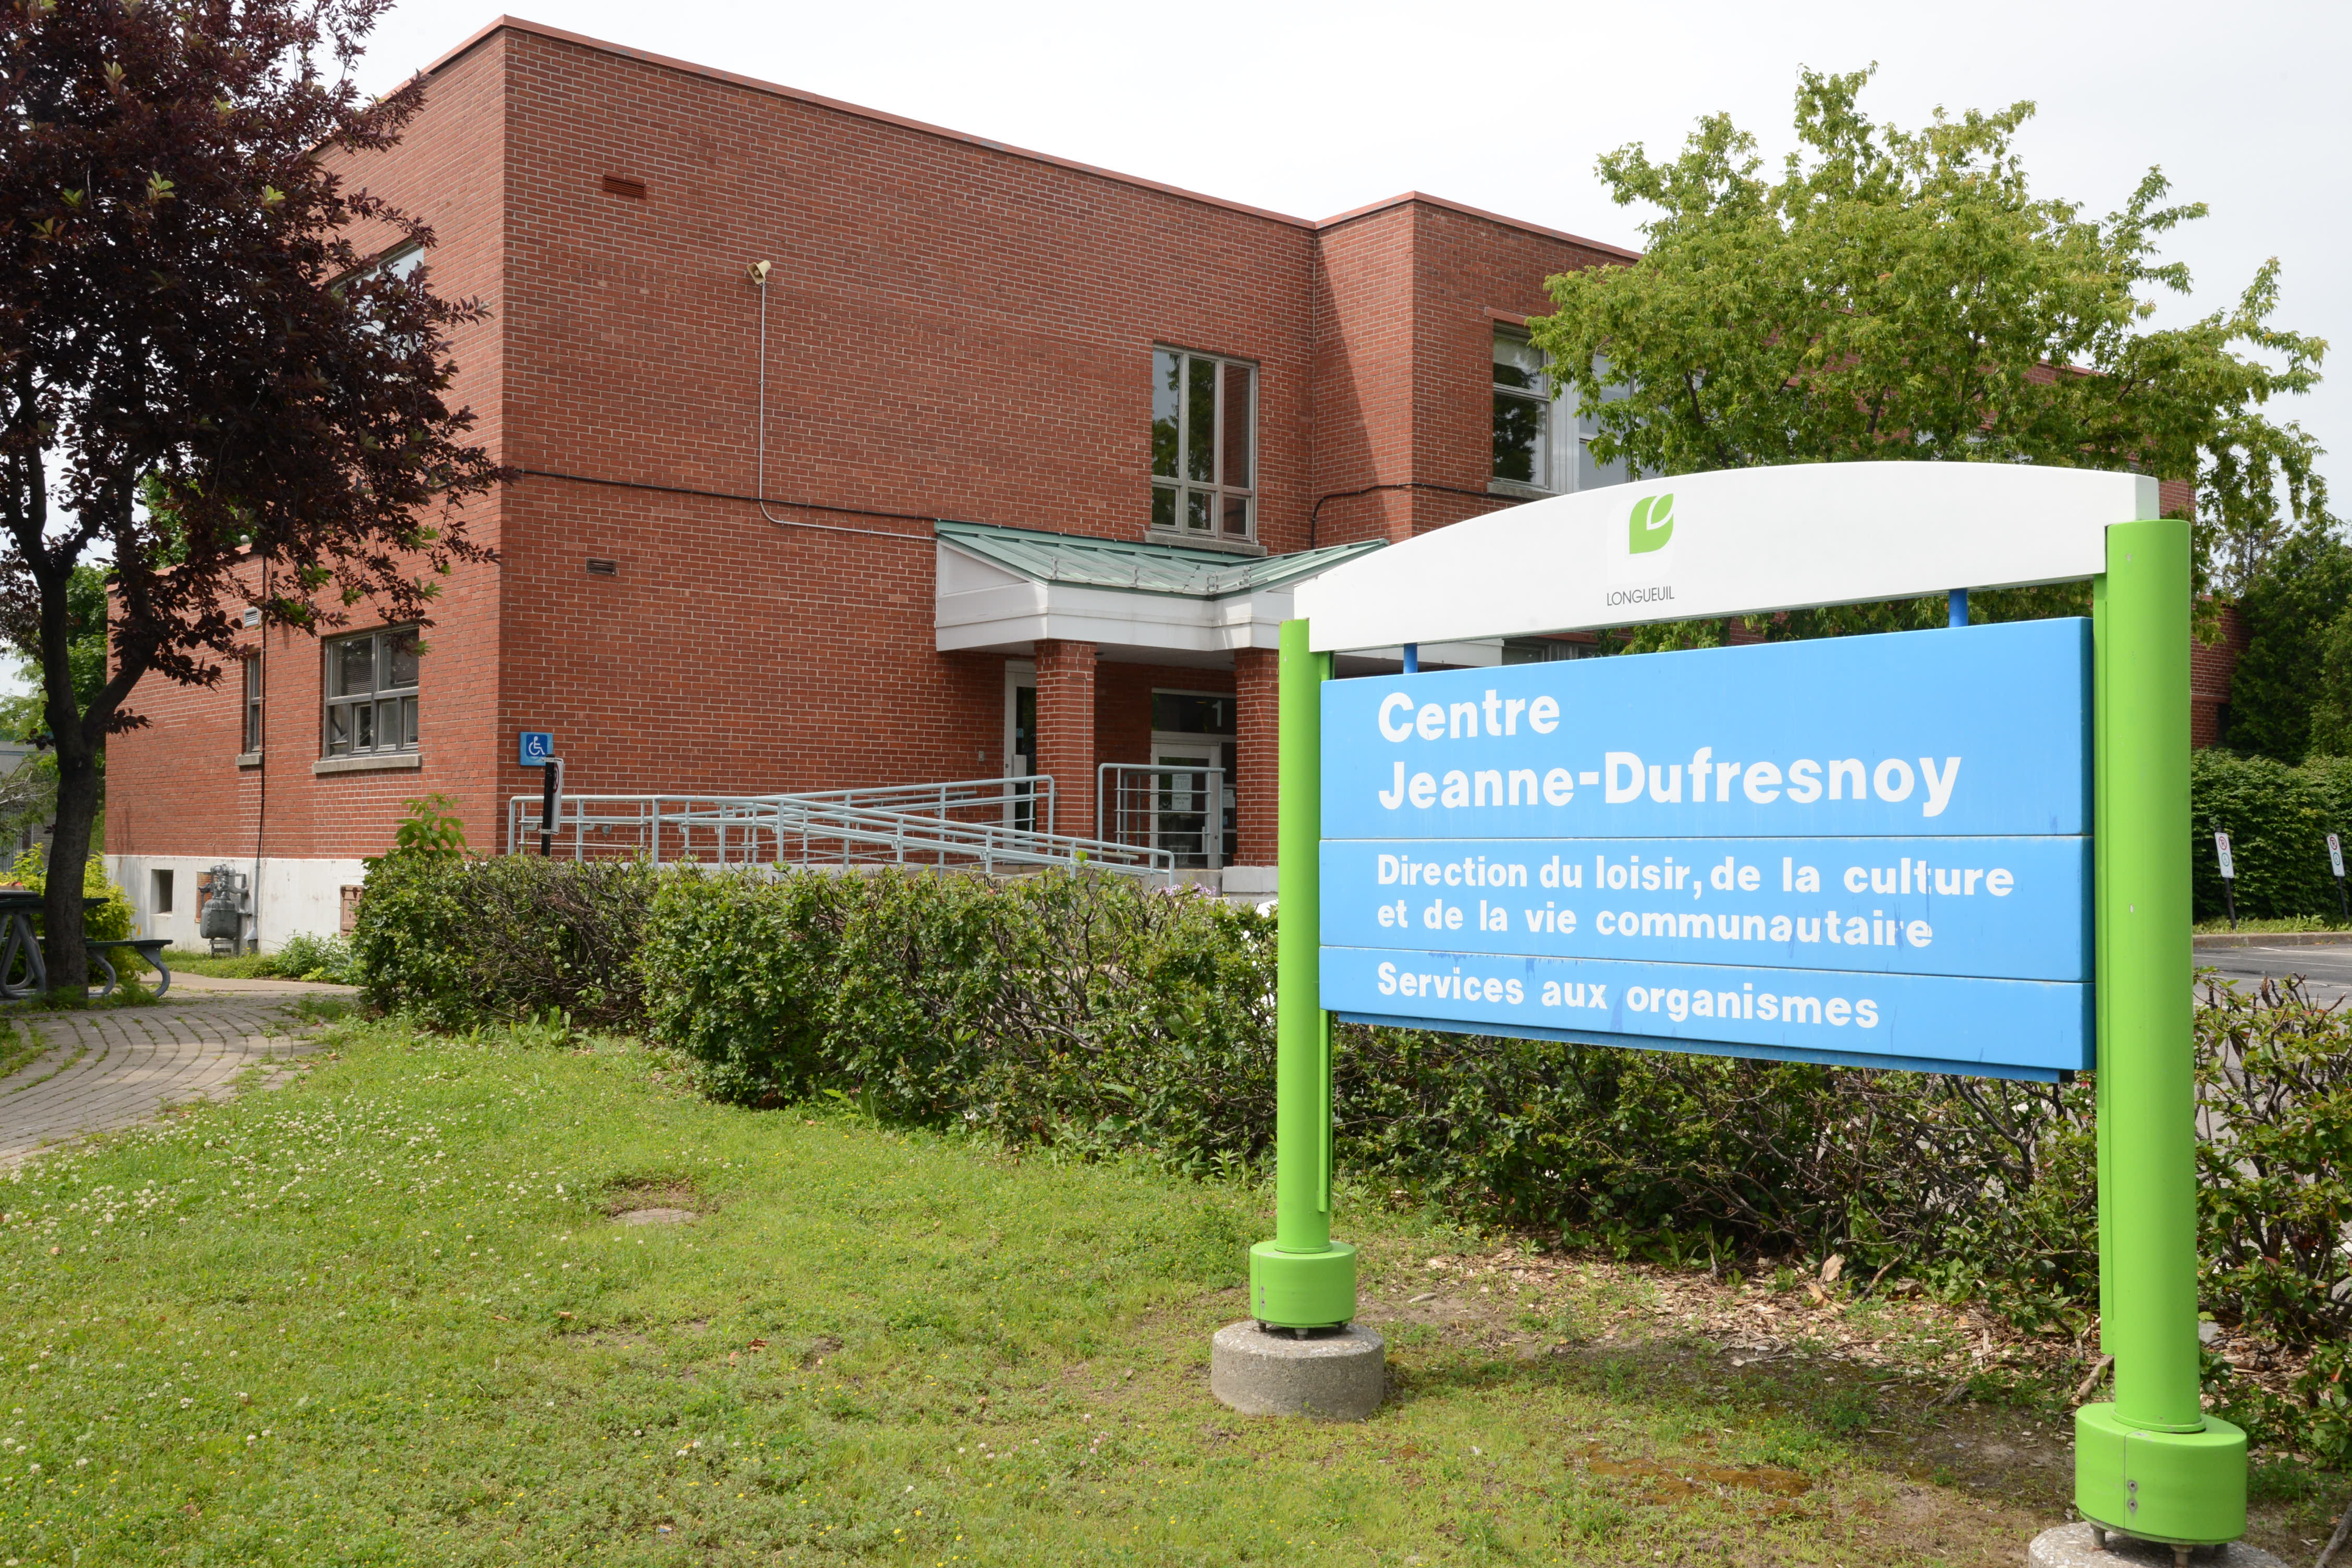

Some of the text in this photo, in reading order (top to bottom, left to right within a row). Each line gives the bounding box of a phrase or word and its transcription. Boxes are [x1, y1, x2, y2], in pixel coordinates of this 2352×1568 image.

[1607, 586, 1674, 606] LONGUEUIL
[1378, 689, 1560, 743] Centre
[1378, 746, 1963, 818] Jeanne-Dufresnoy
[1377, 854, 2014, 900] Direction du loisir, de la culture
[1377, 898, 1933, 948] et de la vie communautaire
[1377, 961, 1879, 1028] Services aux organismes
